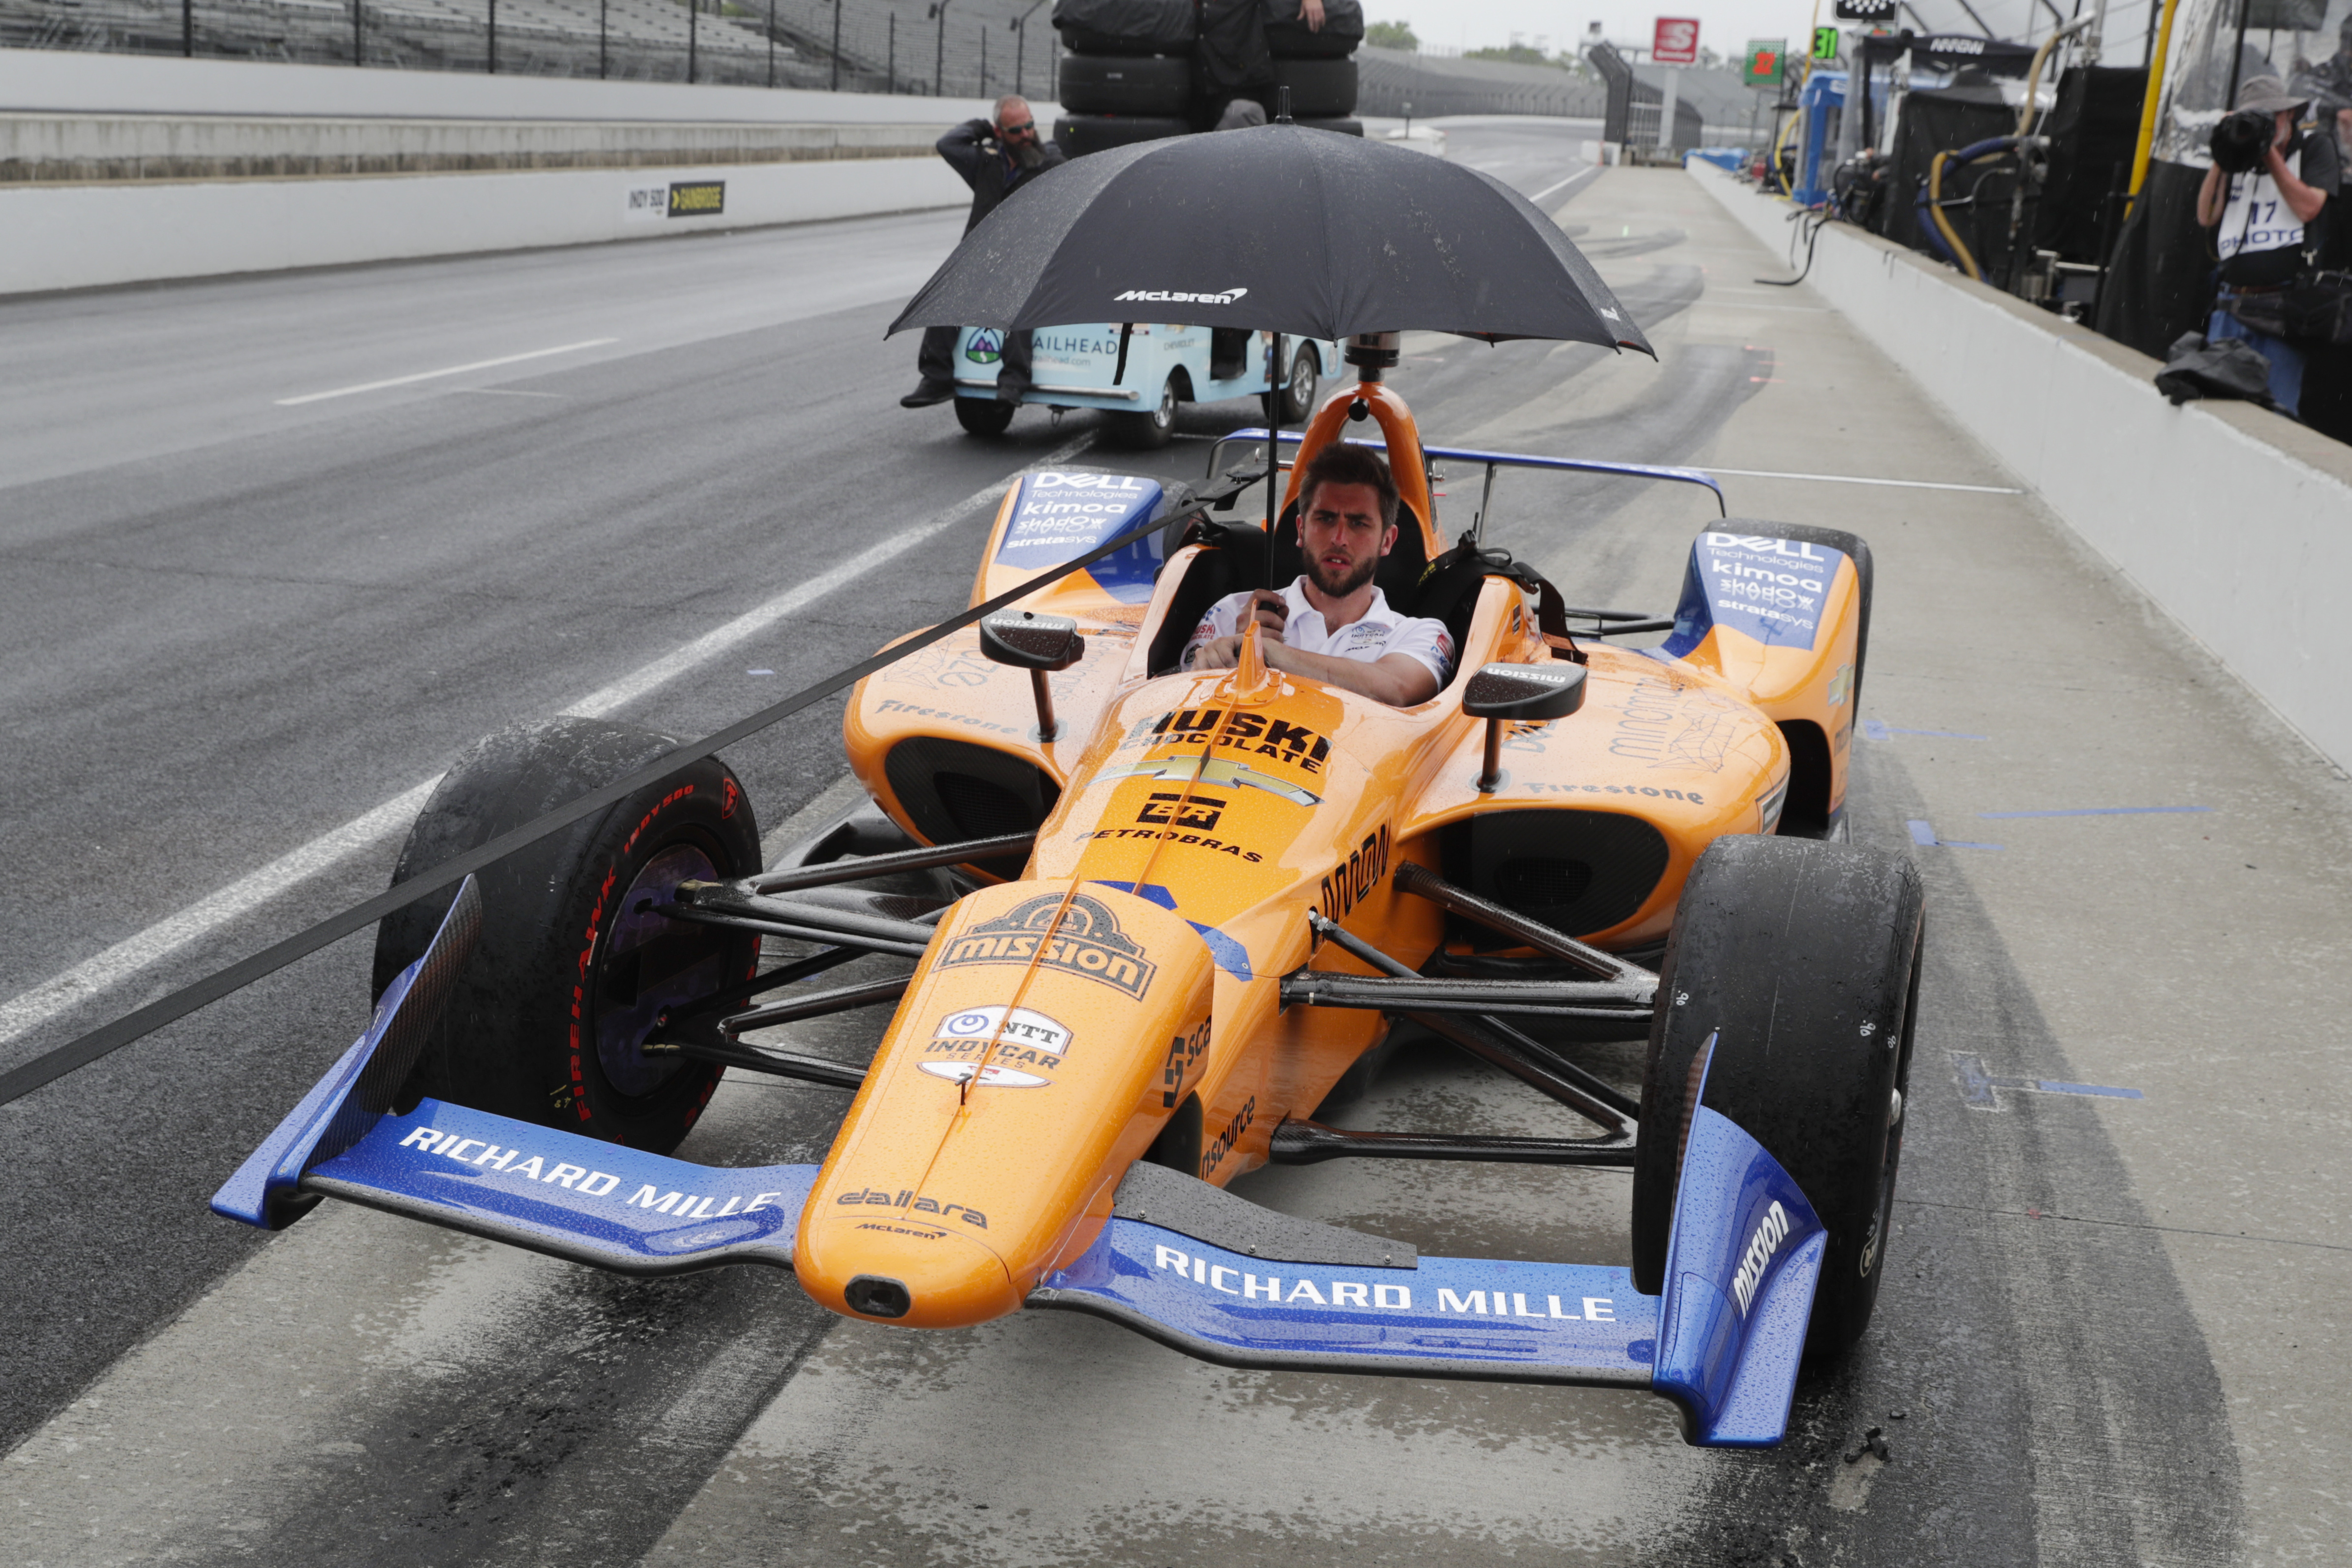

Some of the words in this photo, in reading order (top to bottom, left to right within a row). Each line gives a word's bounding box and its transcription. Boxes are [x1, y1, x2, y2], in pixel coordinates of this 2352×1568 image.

[1814, 27, 1838, 59] 31
[1114, 288, 1247, 304] McLaren
[1033, 336, 1118, 355] AILHEAD
[1030, 489, 1138, 500] Technologies
[1033, 472, 1143, 491] DELL
[1022, 500, 1129, 515] kimoa
[1006, 535, 1098, 549] stratasys
[1706, 531, 1825, 562] DELL
[1707, 547, 1824, 574] Technologies
[1712, 559, 1823, 594] kimoa
[1718, 599, 1814, 630] stratasys
[875, 699, 1018, 734] Firestone
[1128, 710, 1333, 766] HUSKI
[1118, 733, 1322, 775] CHOCOLATE
[662, 784, 694, 807] 500
[1523, 782, 1705, 806] Firestone
[1072, 828, 1263, 863] PETROBRAS
[569, 863, 617, 1122] FIREHAWK
[994, 1020, 1059, 1044] NTT
[925, 1040, 1060, 1071] INDYCAR
[947, 1052, 1026, 1069] SERIES
[398, 1126, 621, 1197] RICHARD
[627, 1184, 781, 1218] MILLE
[836, 1188, 988, 1230] dallara
[854, 1223, 948, 1240] McLaren
[1155, 1244, 1412, 1310] RICHARD
[1437, 1287, 1616, 1322] MILLE
